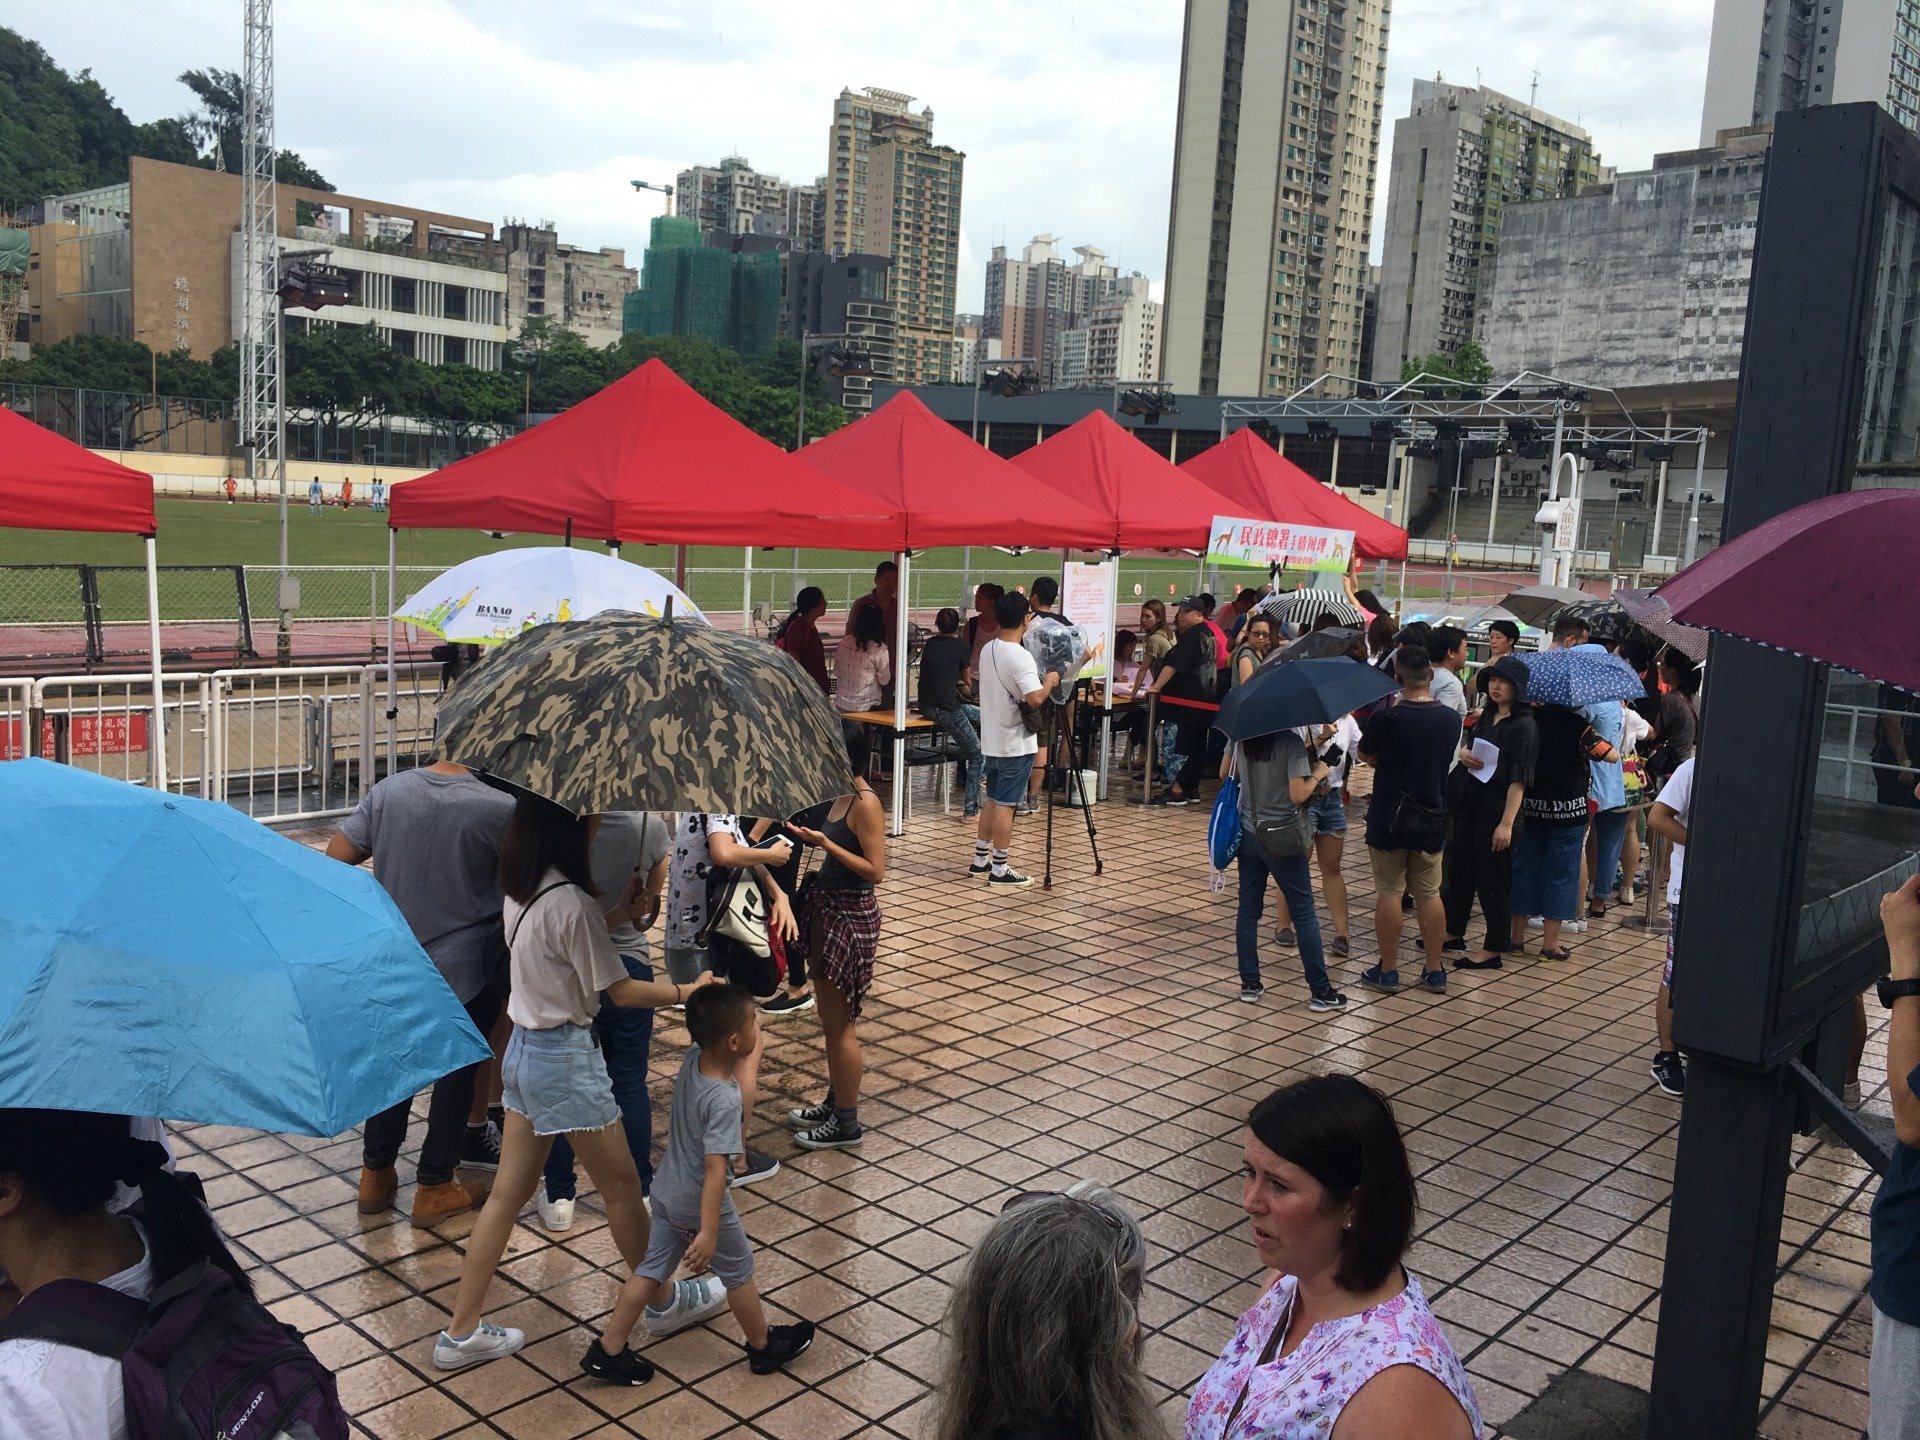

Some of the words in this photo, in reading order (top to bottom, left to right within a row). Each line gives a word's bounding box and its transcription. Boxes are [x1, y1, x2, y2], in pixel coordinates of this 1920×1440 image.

[478, 605, 512, 615] BANAO
[1523, 798, 1551, 811] EVIL
[1552, 796, 1587, 812] DOER
